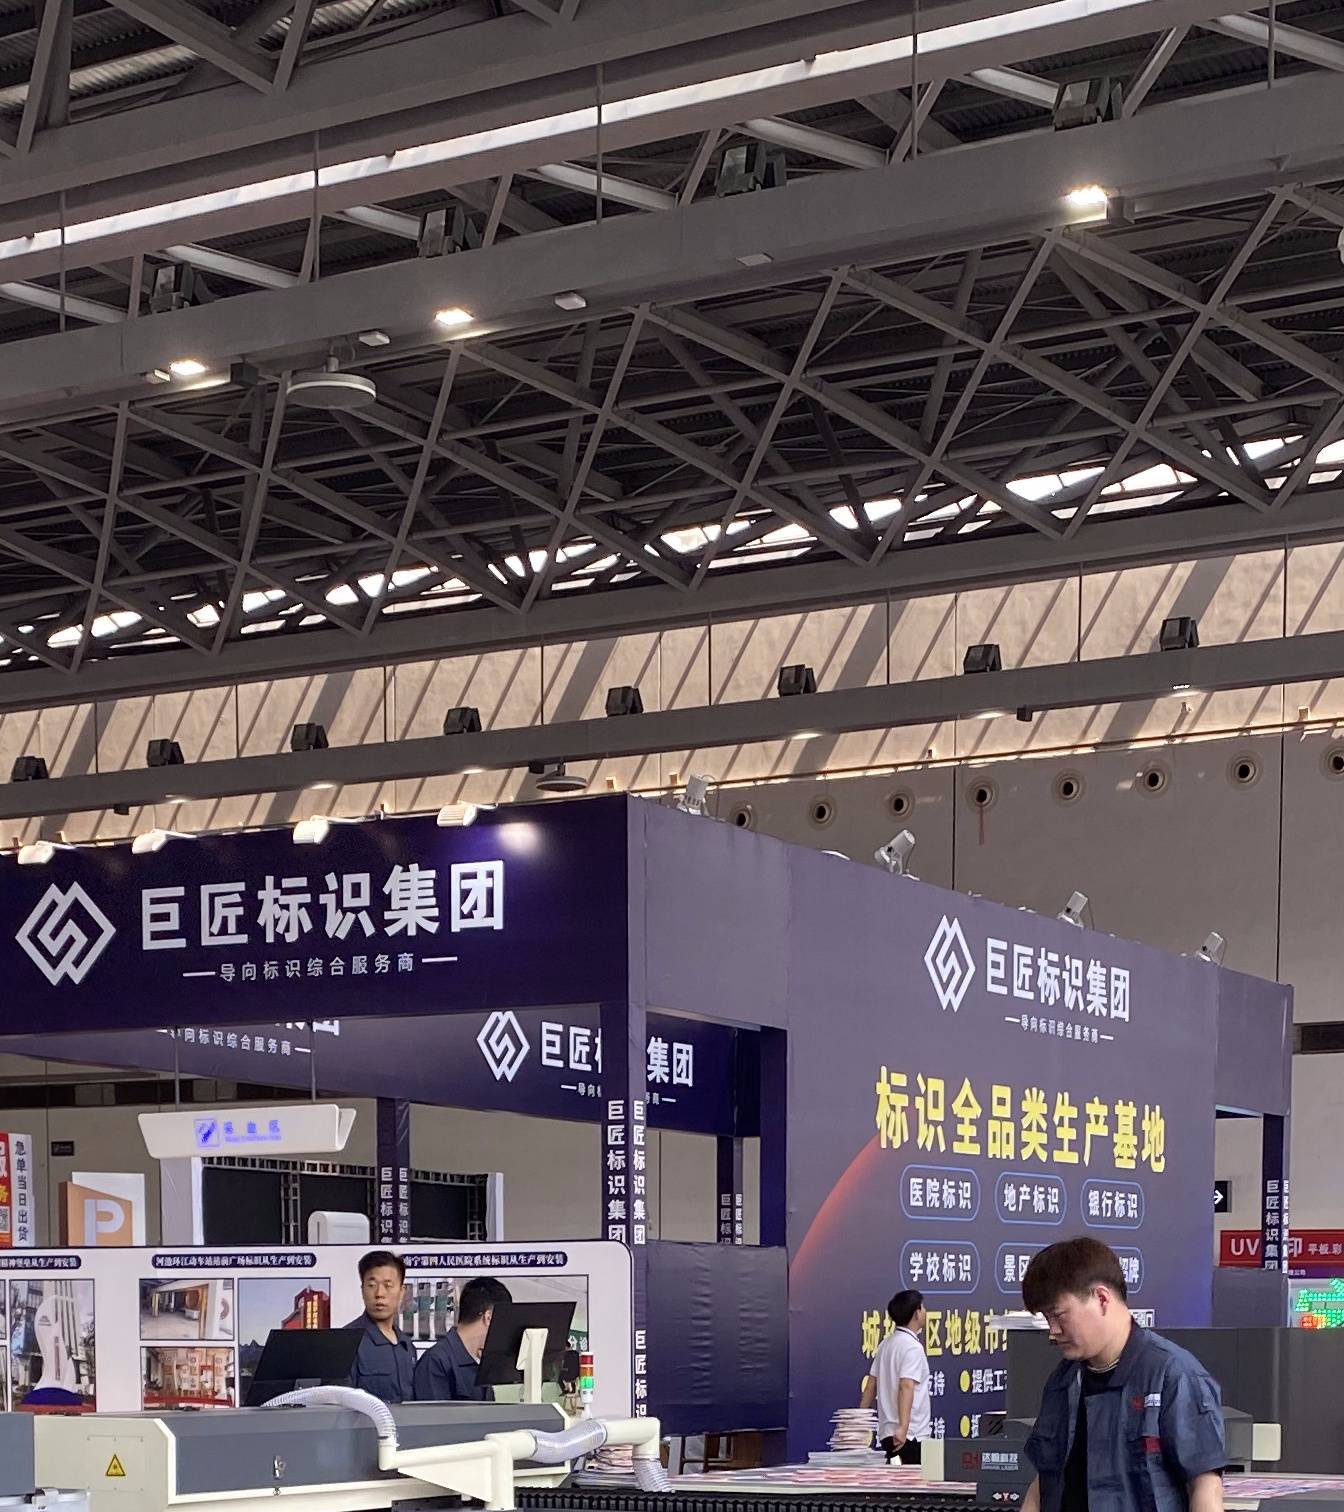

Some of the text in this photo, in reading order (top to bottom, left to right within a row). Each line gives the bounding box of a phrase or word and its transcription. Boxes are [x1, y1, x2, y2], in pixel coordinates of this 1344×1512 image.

[142, 859, 505, 951] 巨匠标识集团
[220, 954, 414, 982] 导向标识综合服务商
[986, 937, 1130, 1022] 巨匠标识集团
[541, 1021, 693, 1087] 巨匠集团
[875, 1065, 1165, 1173] 标识全品类生产基地
[15, 1141, 29, 1241] 急单当日出货
[607, 1100, 626, 1240] 巨匠标识集团
[633, 1100, 646, 1245] 巨匠标识集团
[910, 1177, 971, 1209] 医院标识
[84, 1199, 124, 1246] P
[1004, 1184, 1059, 1213] 地产标识
[1088, 1190, 1138, 1218] 银行标识
[1265, 1180, 1279, 1270] 巨匠标识集团
[910, 1252, 971, 1282] 学校标识
[1231, 1237, 1303, 1258] UV印
[972, 1369, 1007, 1393] 提供工
